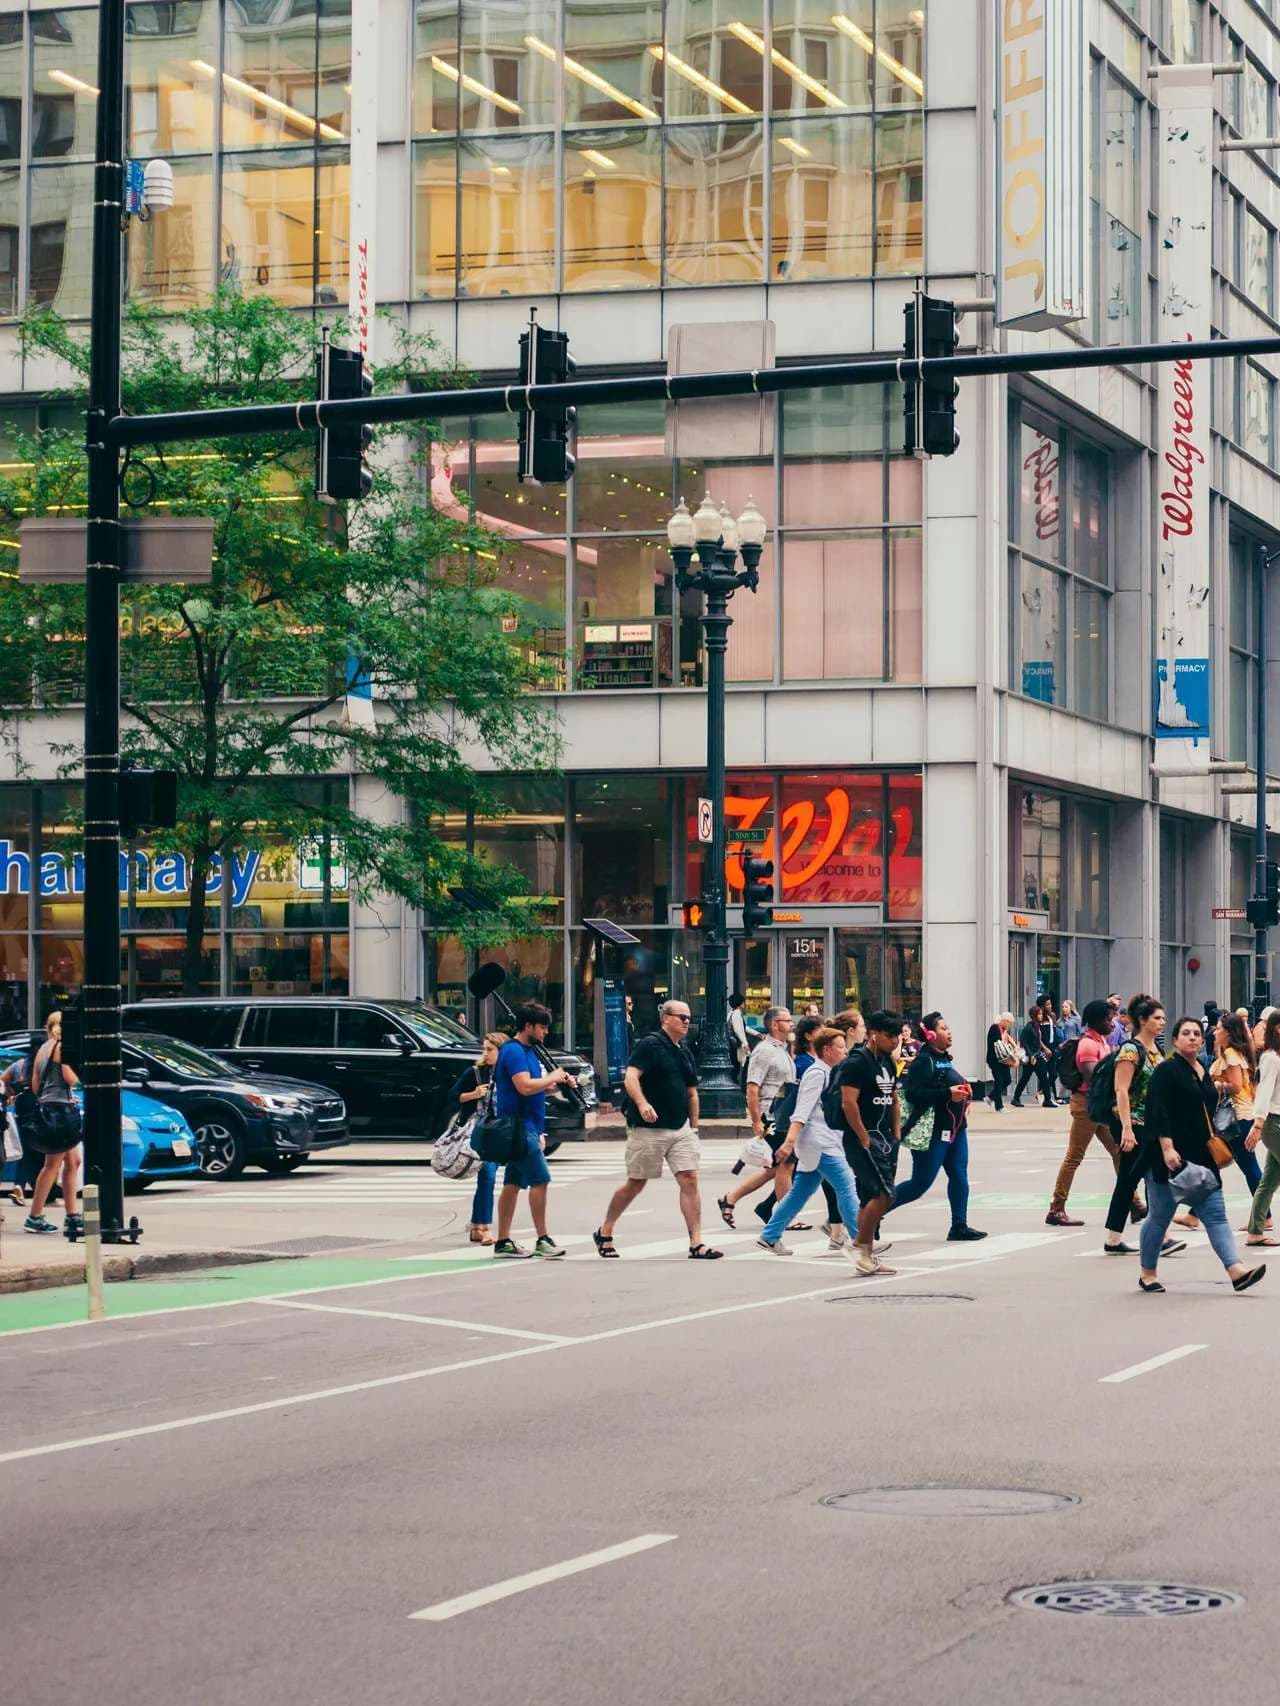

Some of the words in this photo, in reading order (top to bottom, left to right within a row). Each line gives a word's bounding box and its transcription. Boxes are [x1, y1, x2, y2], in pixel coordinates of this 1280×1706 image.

[1157, 664, 1207, 673] PRMACY
[867, 863, 881, 878] to
[793, 938, 816, 953] 151
